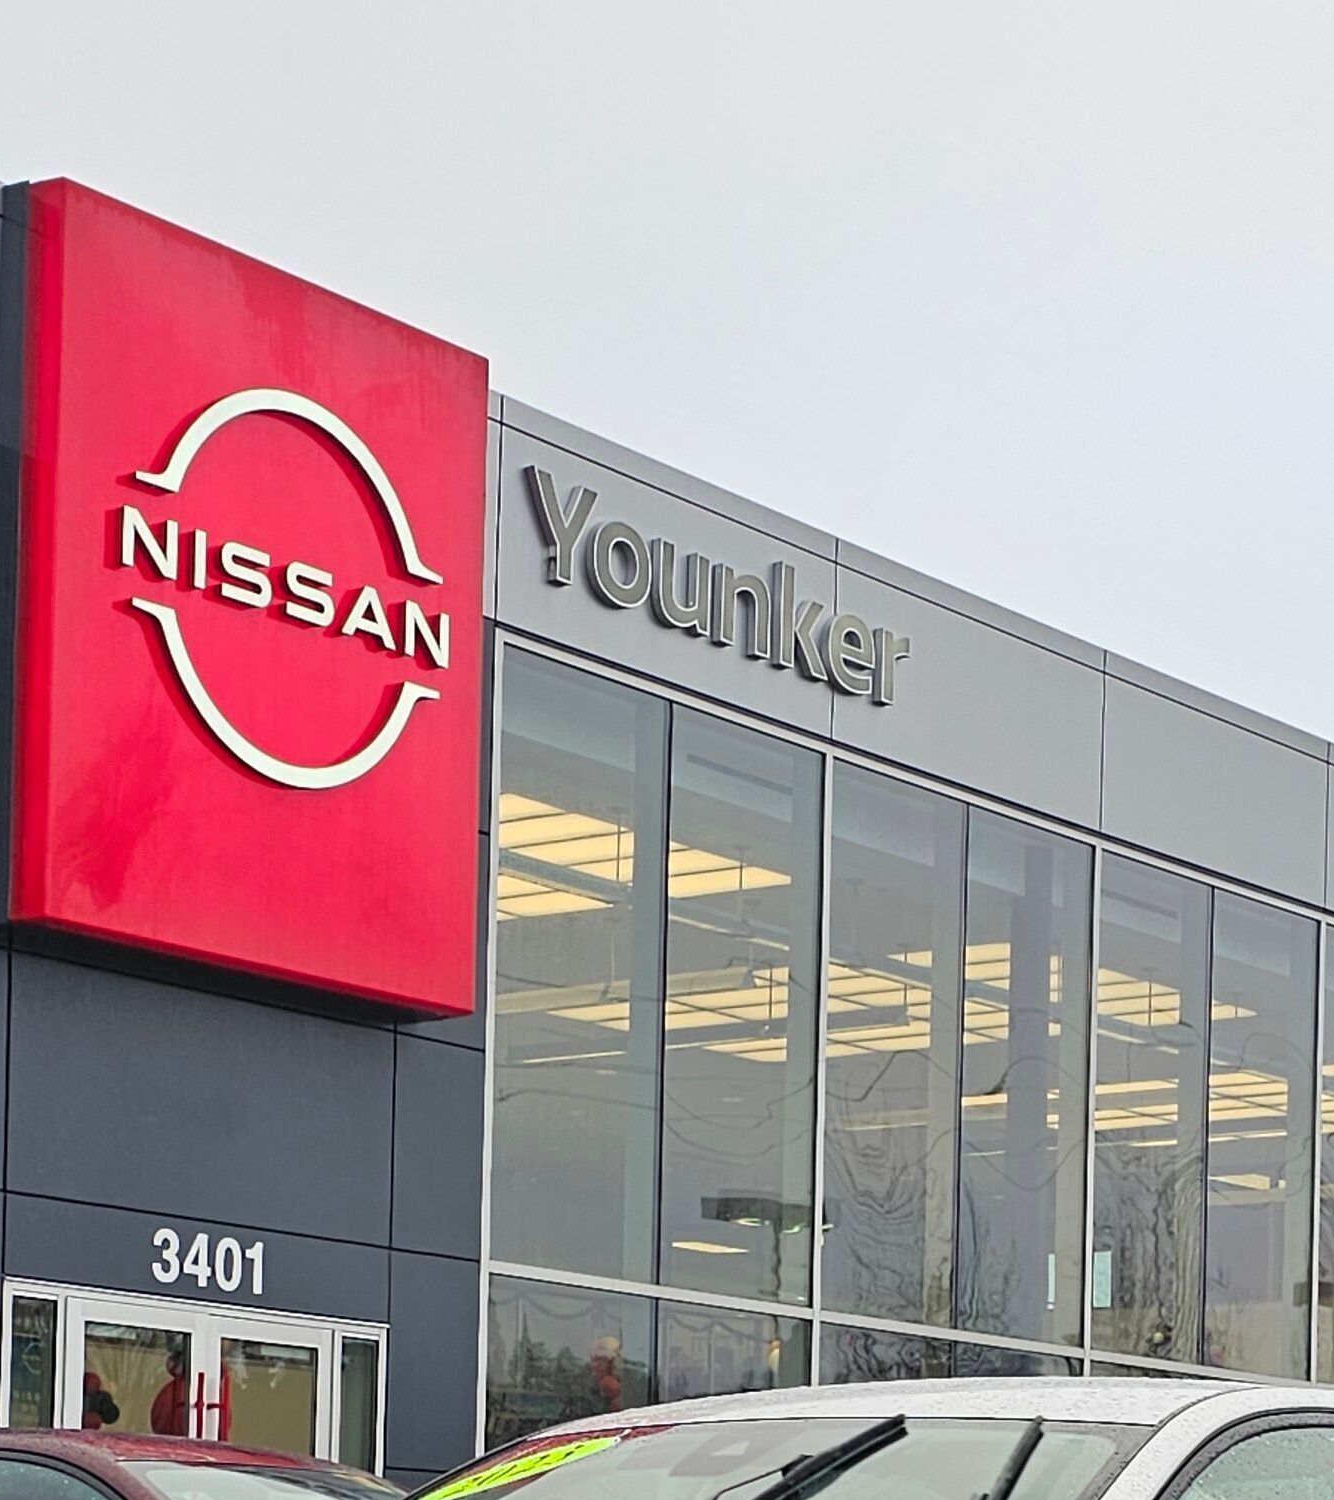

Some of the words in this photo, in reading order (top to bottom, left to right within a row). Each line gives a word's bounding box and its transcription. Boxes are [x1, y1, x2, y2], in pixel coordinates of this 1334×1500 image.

[120, 504, 451, 669] NISSAN
[523, 464, 911, 707] Younker
[151, 1227, 265, 1295] 3401
